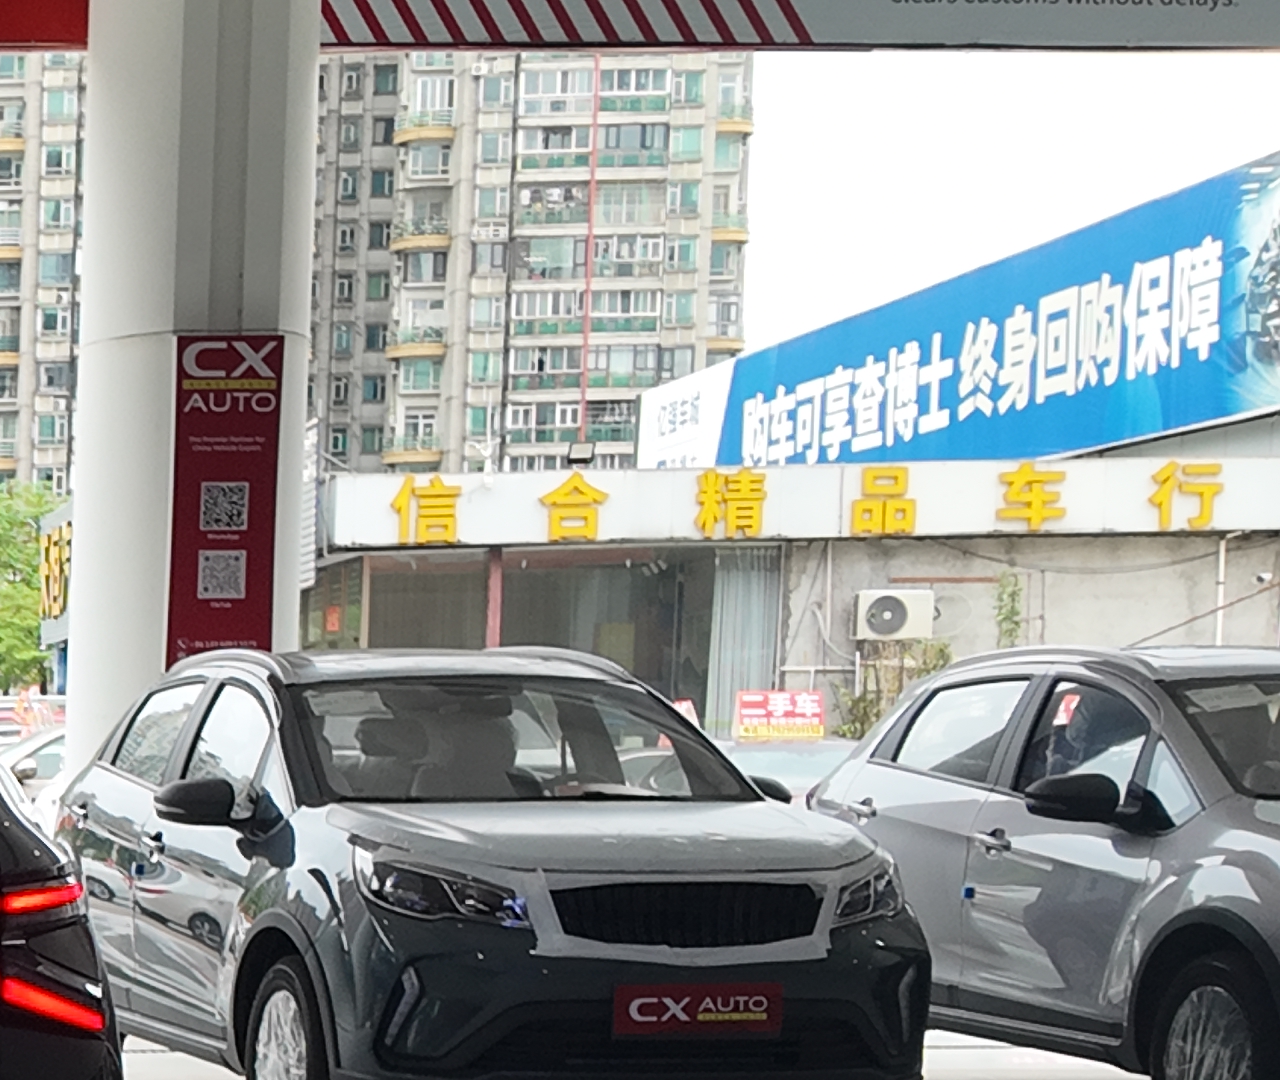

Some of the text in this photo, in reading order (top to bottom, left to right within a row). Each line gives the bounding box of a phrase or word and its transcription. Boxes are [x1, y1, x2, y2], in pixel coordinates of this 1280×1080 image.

[182, 341, 278, 378] CX
[741, 236, 1224, 466] 购车可享查博士 终身回购保障
[183, 392, 276, 412] AUTO
[390, 460, 1223, 546] 信合精品车行
[740, 692, 821, 717] 二手车
[628, 997, 691, 1022] CX
[698, 996, 768, 1012] AUTO
